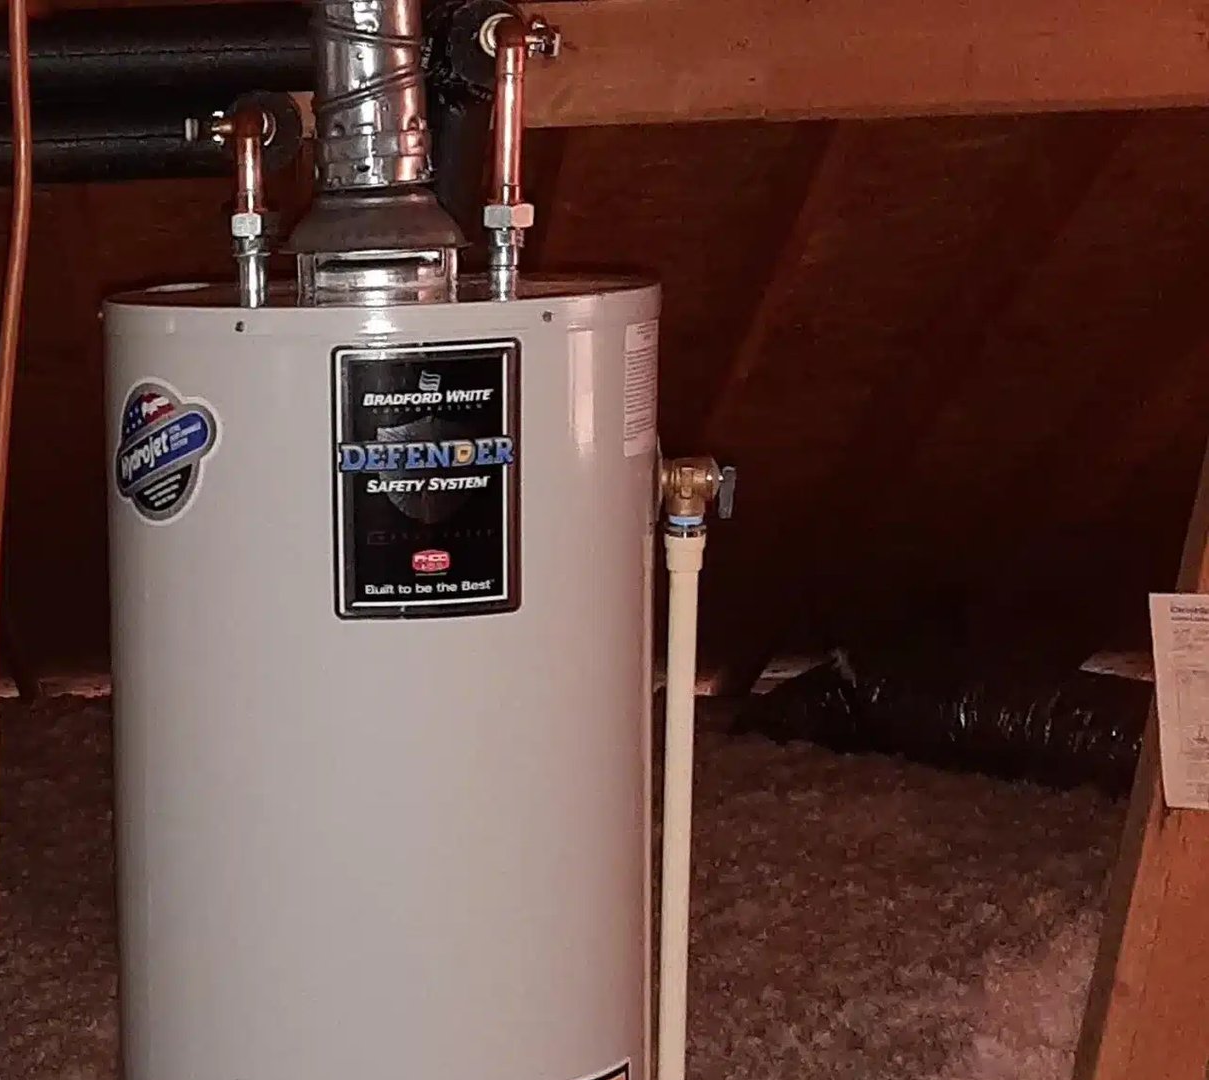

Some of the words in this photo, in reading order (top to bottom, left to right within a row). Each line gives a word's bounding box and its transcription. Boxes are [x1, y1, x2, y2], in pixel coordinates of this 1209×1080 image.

[363, 392, 443, 406] BRADFORD
[445, 389, 492, 403] WHITE
[340, 437, 514, 472] DEFENDER
[367, 479, 426, 493] SAFETY
[428, 476, 490, 491] SYSTEM
[365, 584, 395, 595] Built
[398, 585, 412, 595] to
[415, 583, 432, 594] be
[436, 582, 457, 593] the
[461, 580, 492, 592] Best
